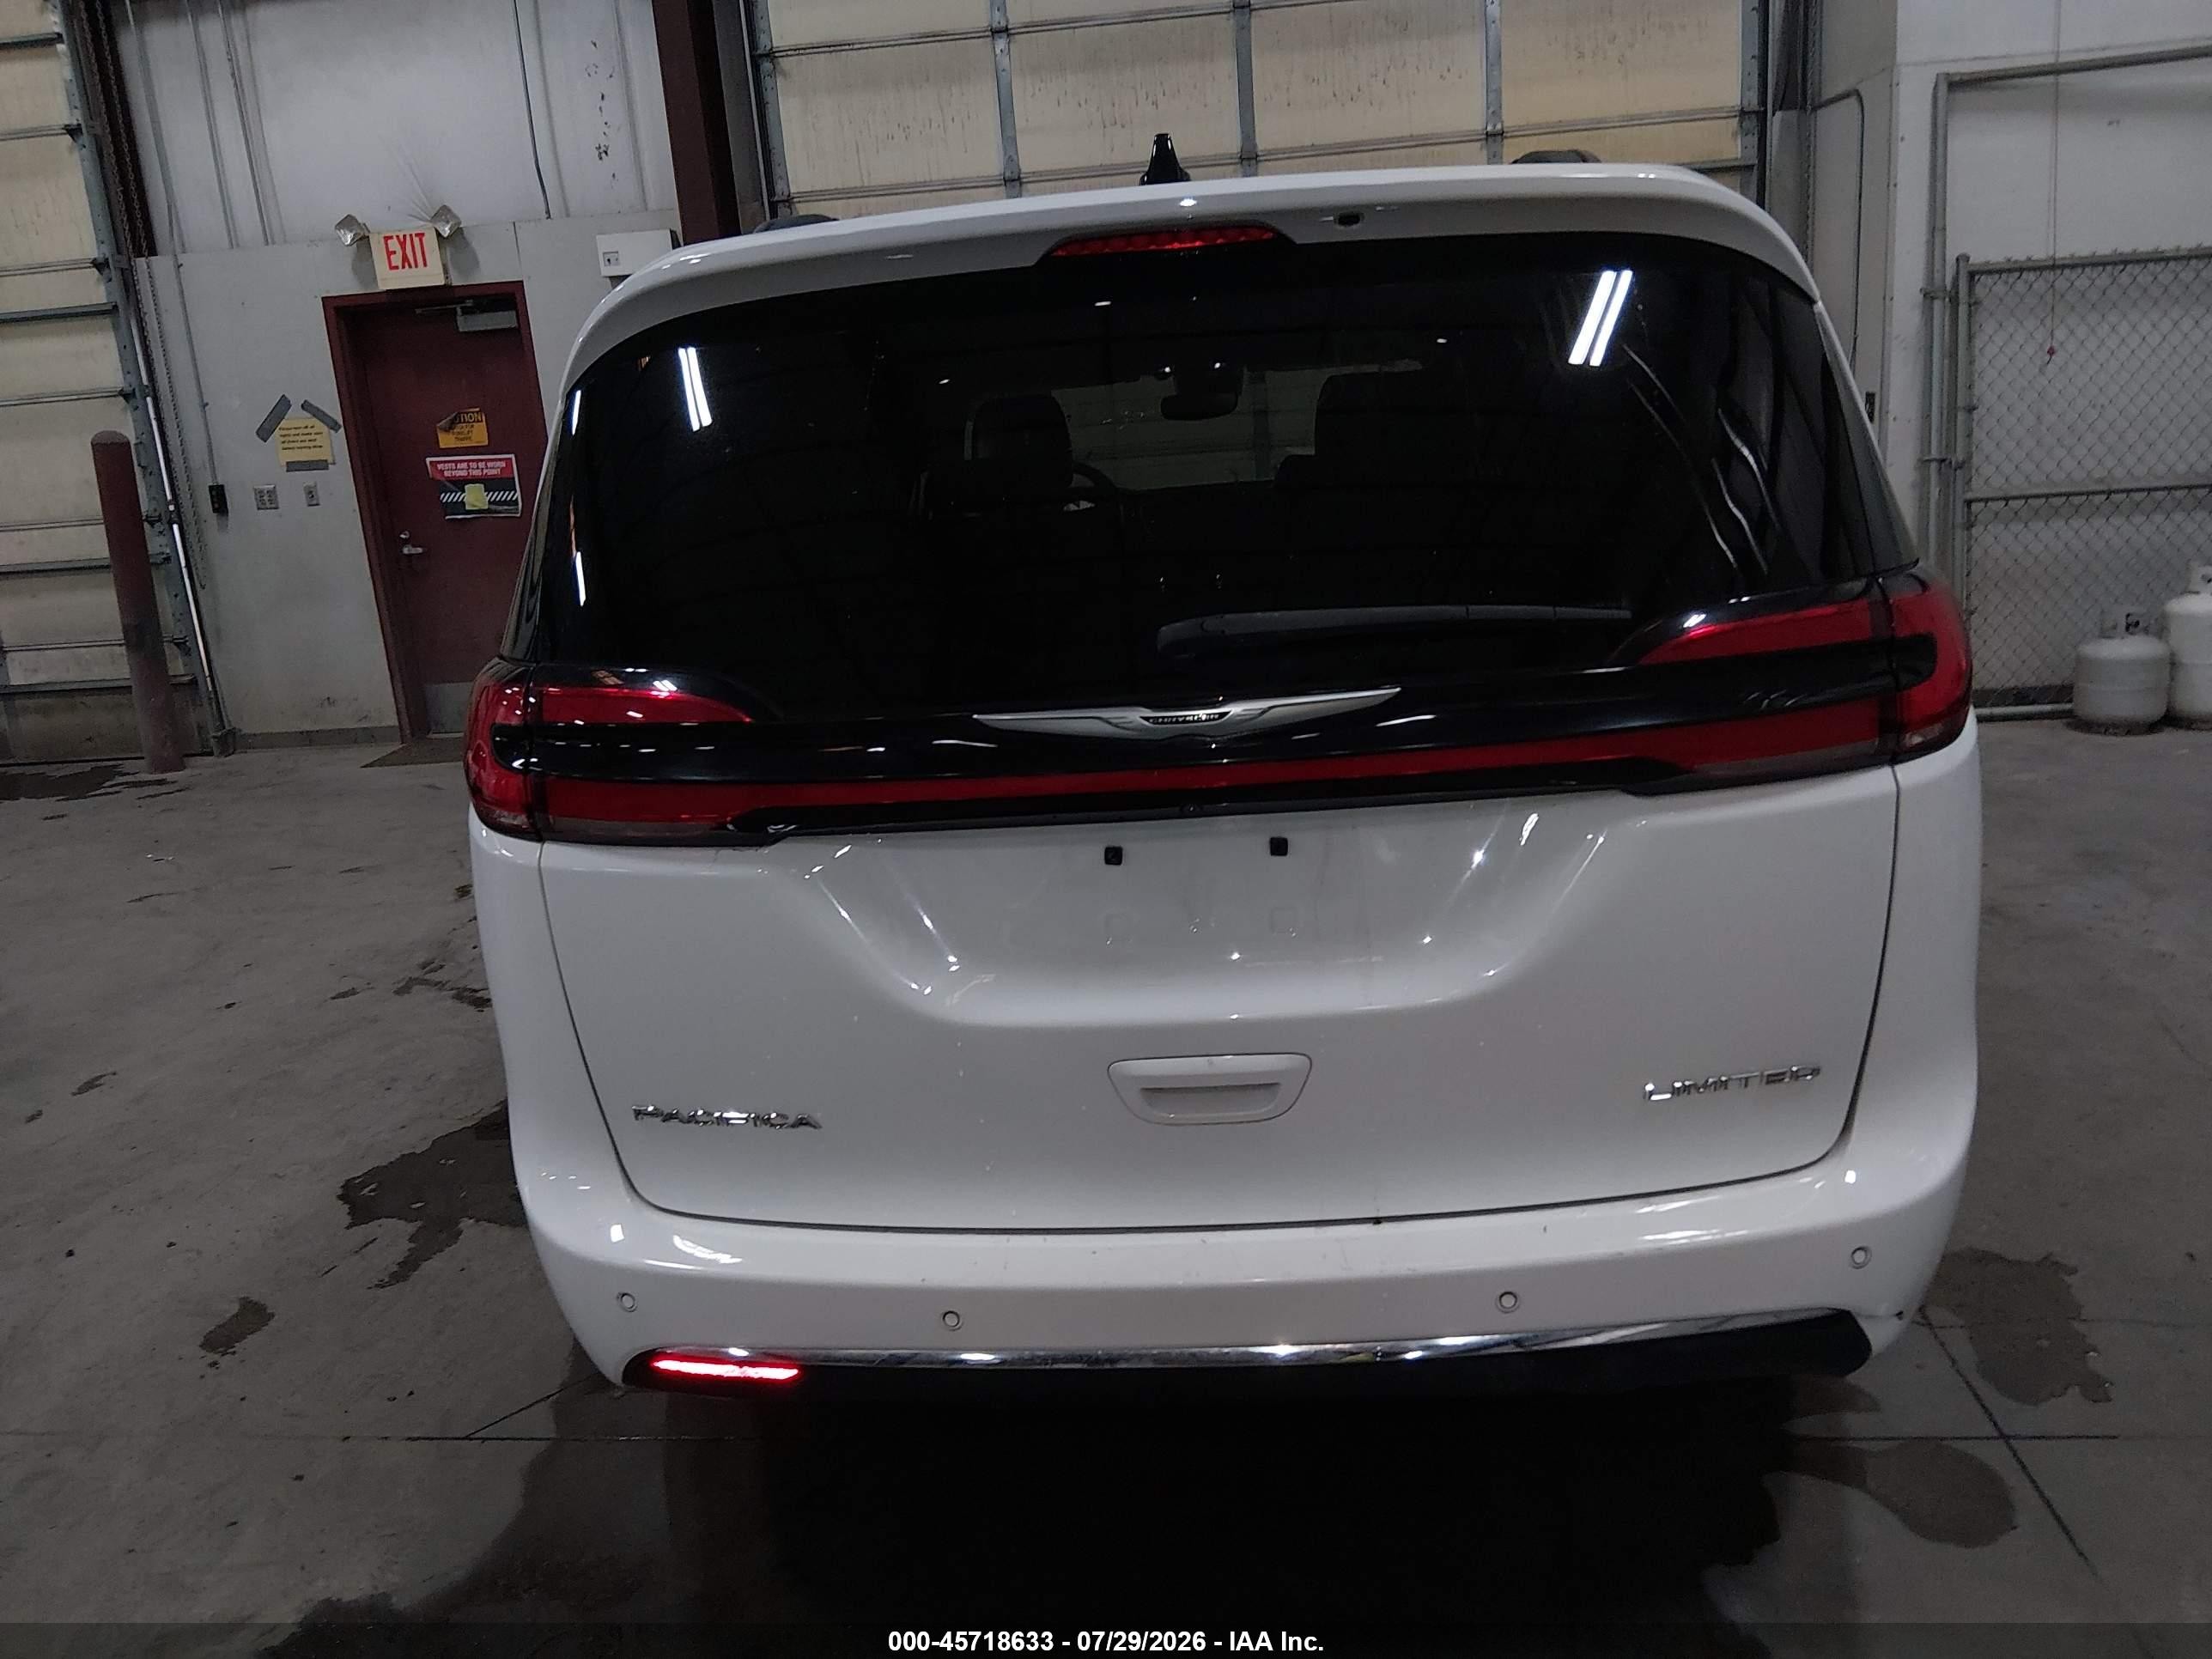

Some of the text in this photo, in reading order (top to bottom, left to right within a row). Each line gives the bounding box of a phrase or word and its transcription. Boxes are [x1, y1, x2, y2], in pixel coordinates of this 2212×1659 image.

[383, 232, 428, 271] EXIT
[1643, 1064, 1821, 1102] LIMITED
[631, 1104, 823, 1130] PACIFICA
